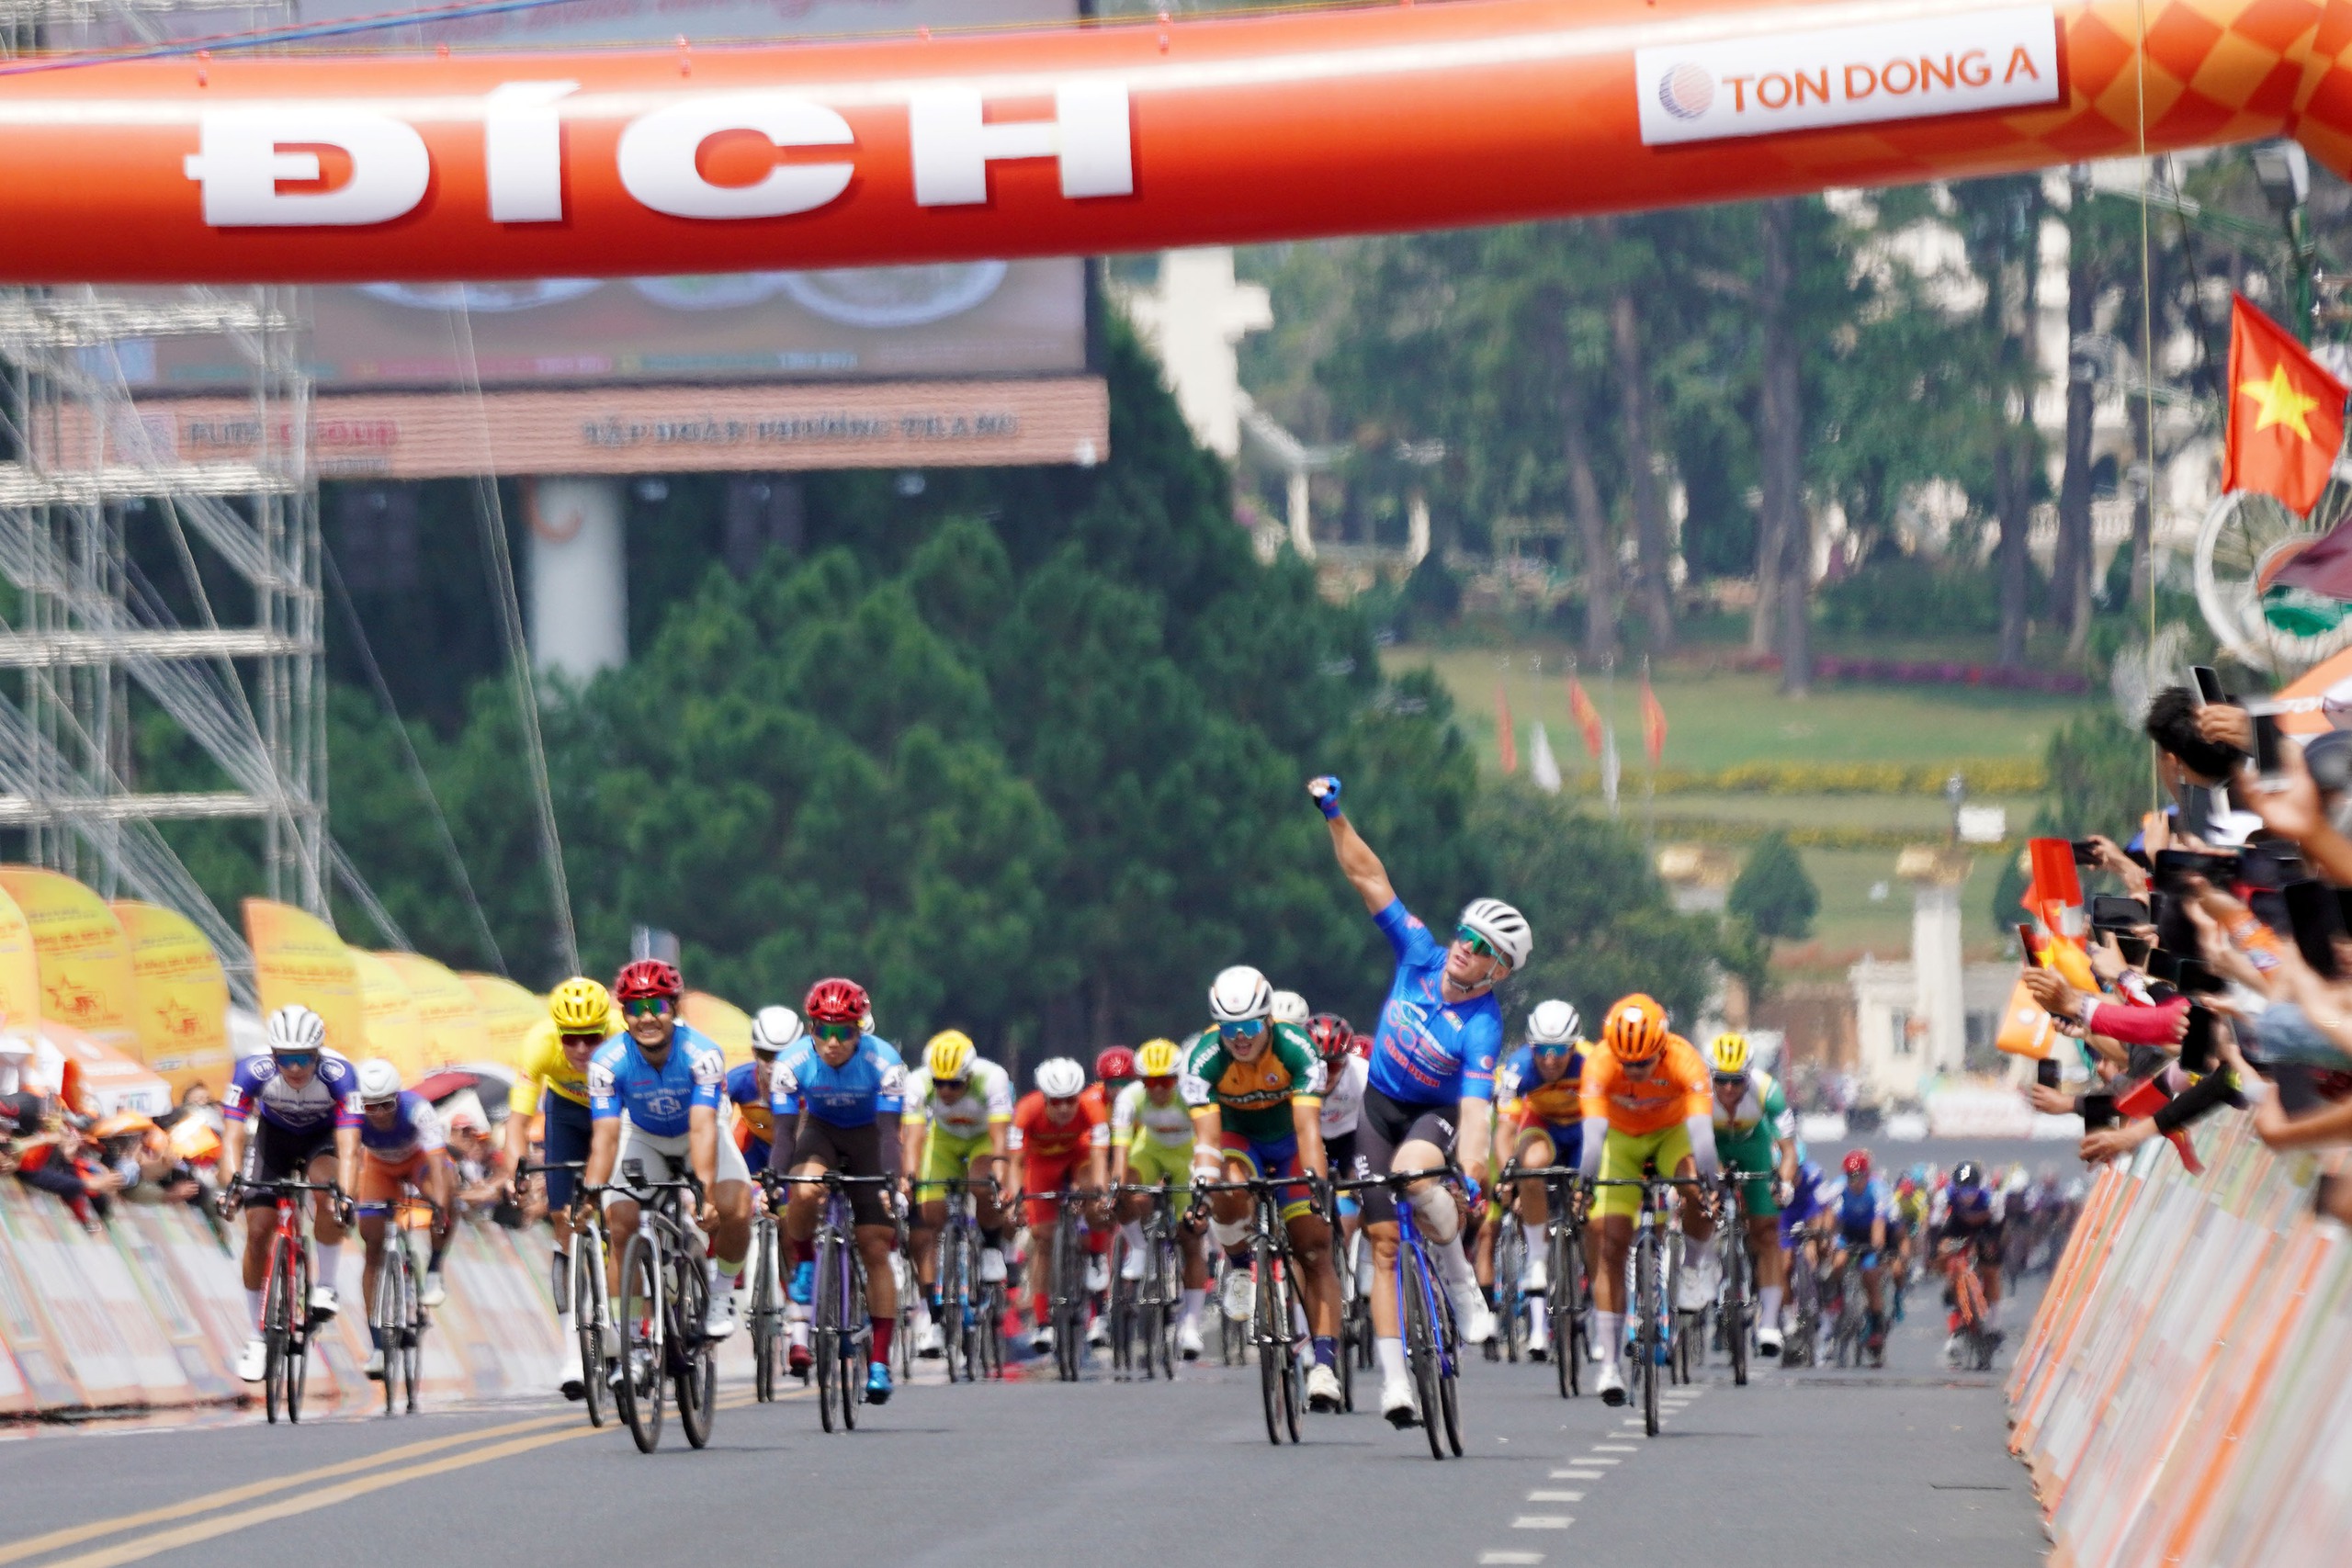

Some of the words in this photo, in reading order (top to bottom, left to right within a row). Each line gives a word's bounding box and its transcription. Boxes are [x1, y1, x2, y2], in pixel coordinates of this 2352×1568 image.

[1722, 65, 1830, 113] TON
[1843, 50, 1993, 102] DONG
[2004, 45, 2040, 85] A
[184, 79, 1134, 227] ĐÍCH
